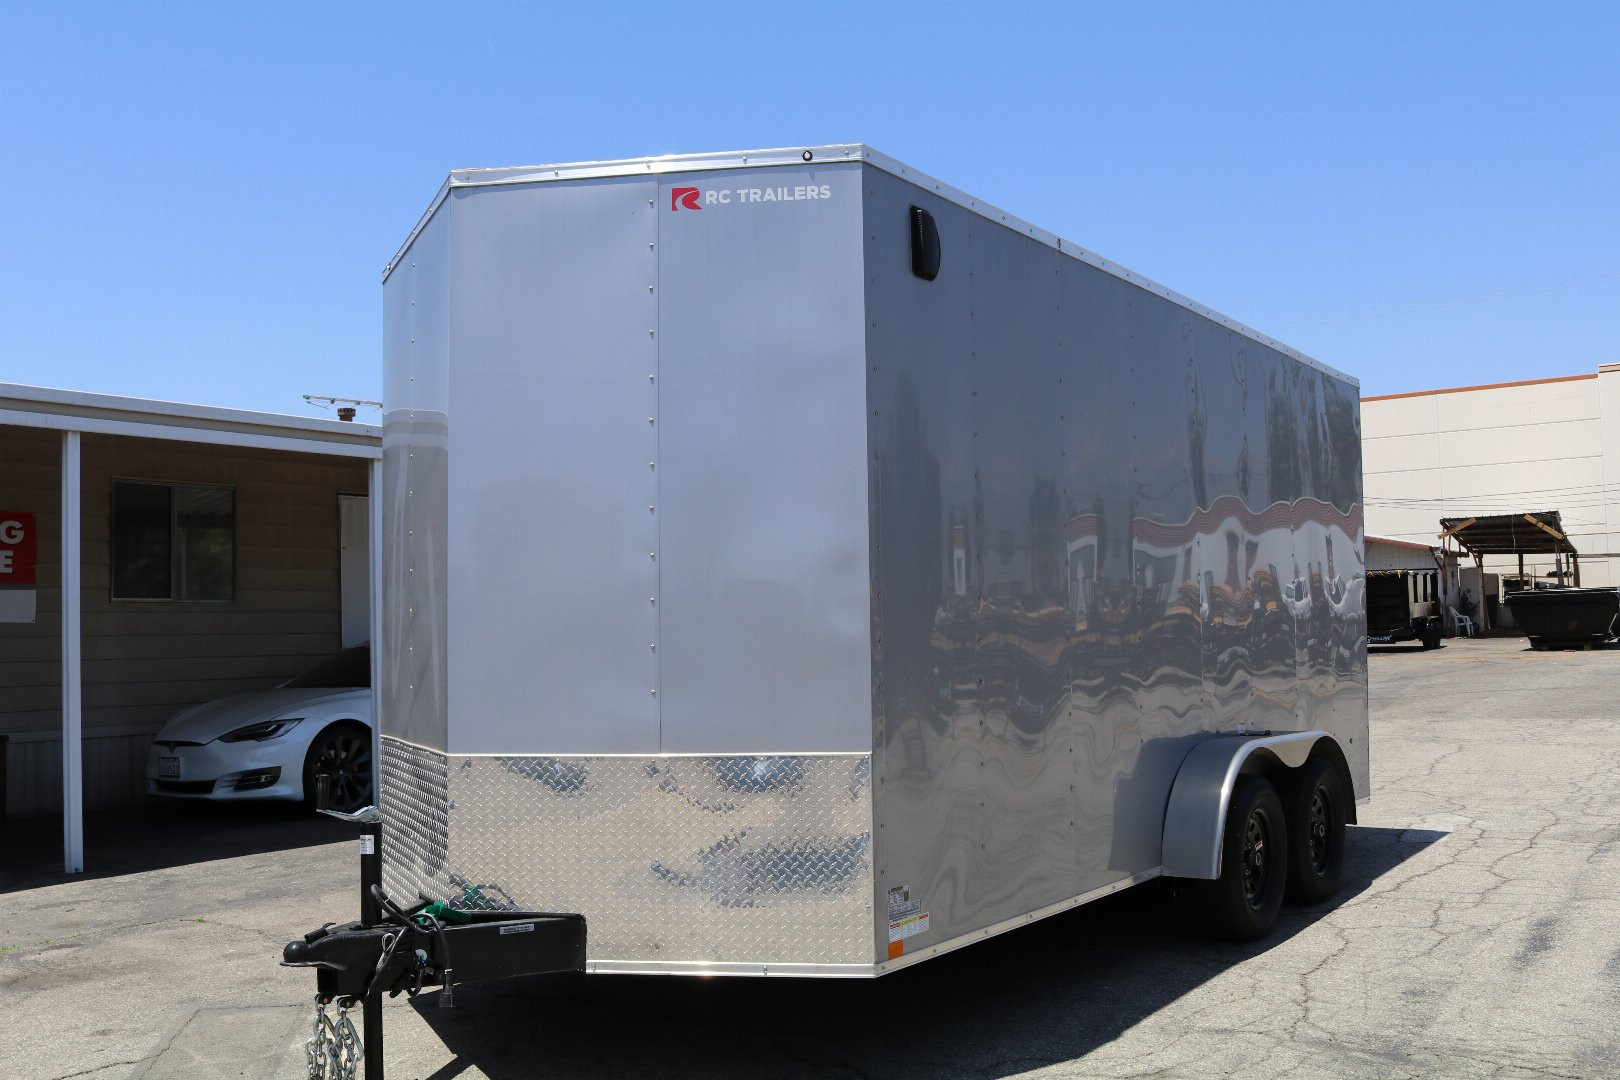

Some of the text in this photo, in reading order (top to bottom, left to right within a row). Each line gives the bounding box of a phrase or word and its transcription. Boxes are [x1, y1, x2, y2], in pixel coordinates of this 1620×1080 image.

[705, 190, 731, 205] RC
[737, 185, 832, 203] TRAILERS
[0, 520, 25, 545] G
[0, 550, 14, 574] E
